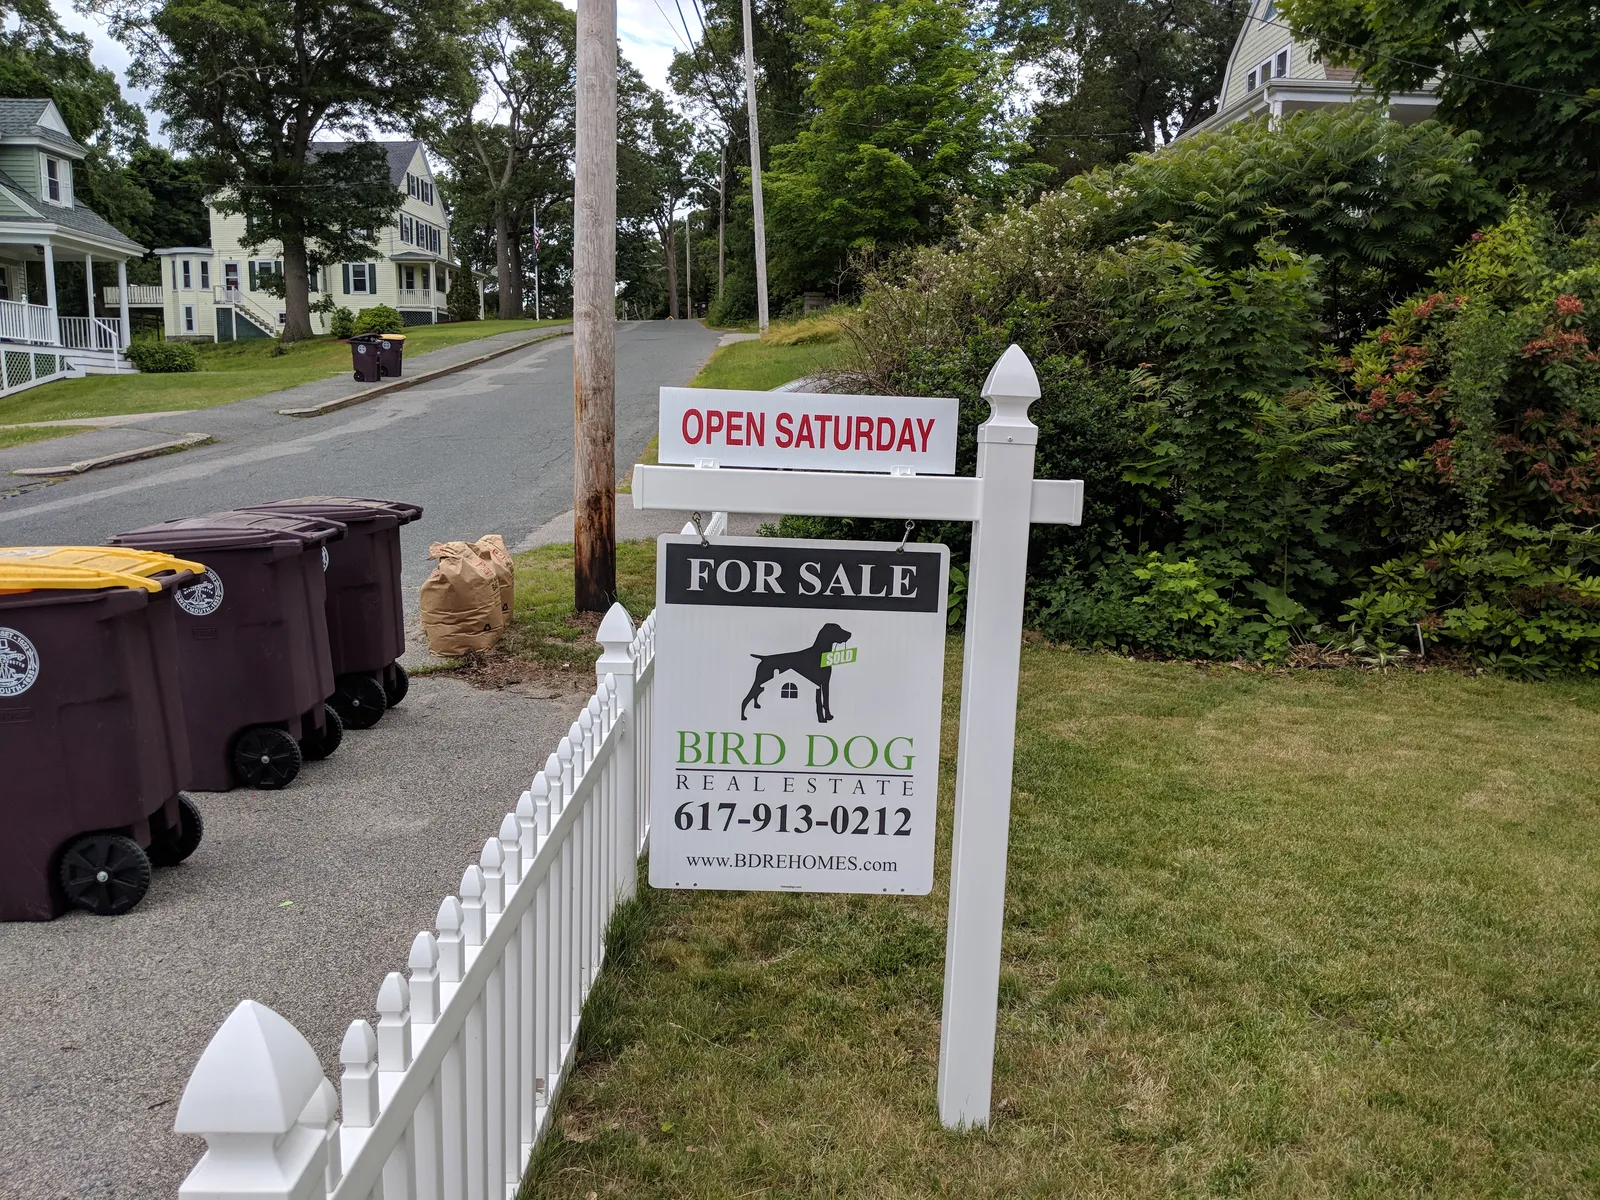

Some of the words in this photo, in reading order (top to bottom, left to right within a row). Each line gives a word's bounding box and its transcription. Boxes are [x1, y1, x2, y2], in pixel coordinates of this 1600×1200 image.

[682, 408, 765, 446] OPEN
[775, 413, 935, 453] SATURDAY
[686, 558, 786, 594] FOR
[798, 562, 918, 598] SALE
[178, 597, 211, 614] WEYMOUTH
[826, 650, 853, 665] SOLD
[676, 730, 786, 766] BIRD
[805, 734, 916, 770] DOG
[674, 801, 912, 837] 617-913-0212
[686, 853, 897, 872] www.BDREHOMES.com
